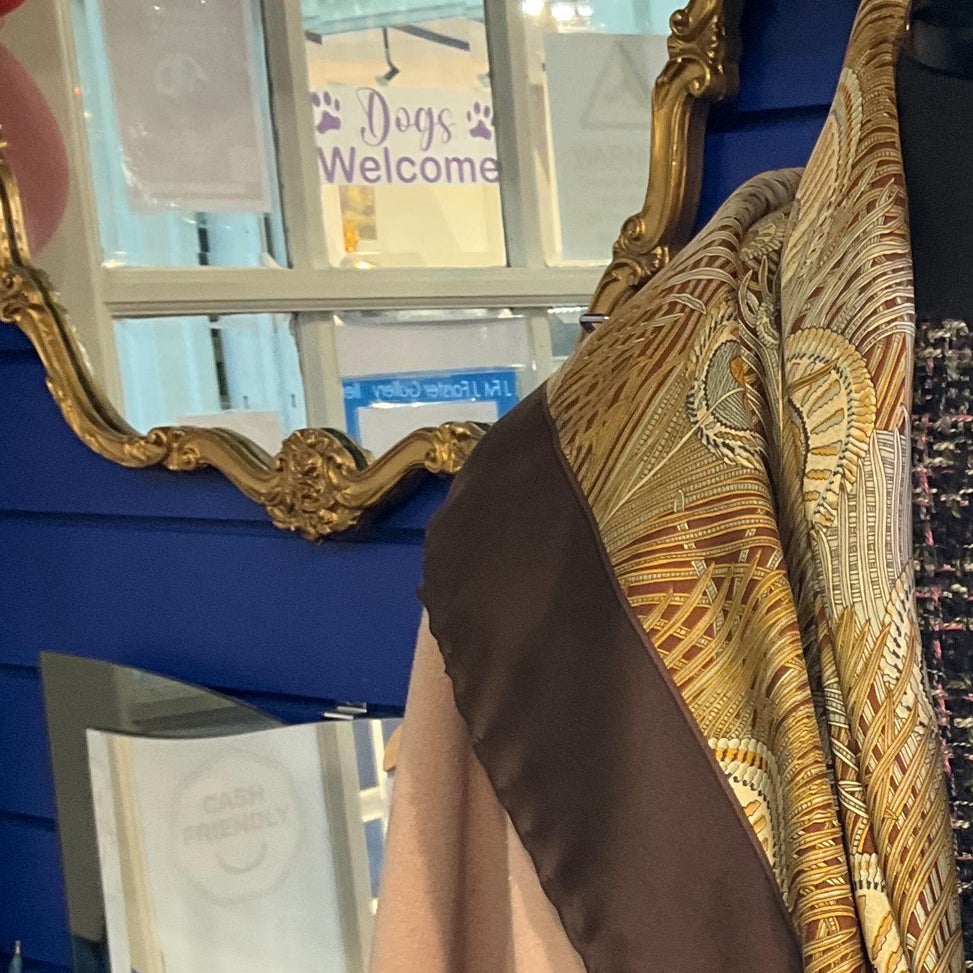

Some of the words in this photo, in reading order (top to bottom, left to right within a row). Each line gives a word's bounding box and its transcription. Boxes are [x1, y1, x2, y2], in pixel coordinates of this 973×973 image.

[355, 87, 456, 151] Dogs
[319, 146, 500, 183] Welcome
[203, 785, 264, 813] CASH
